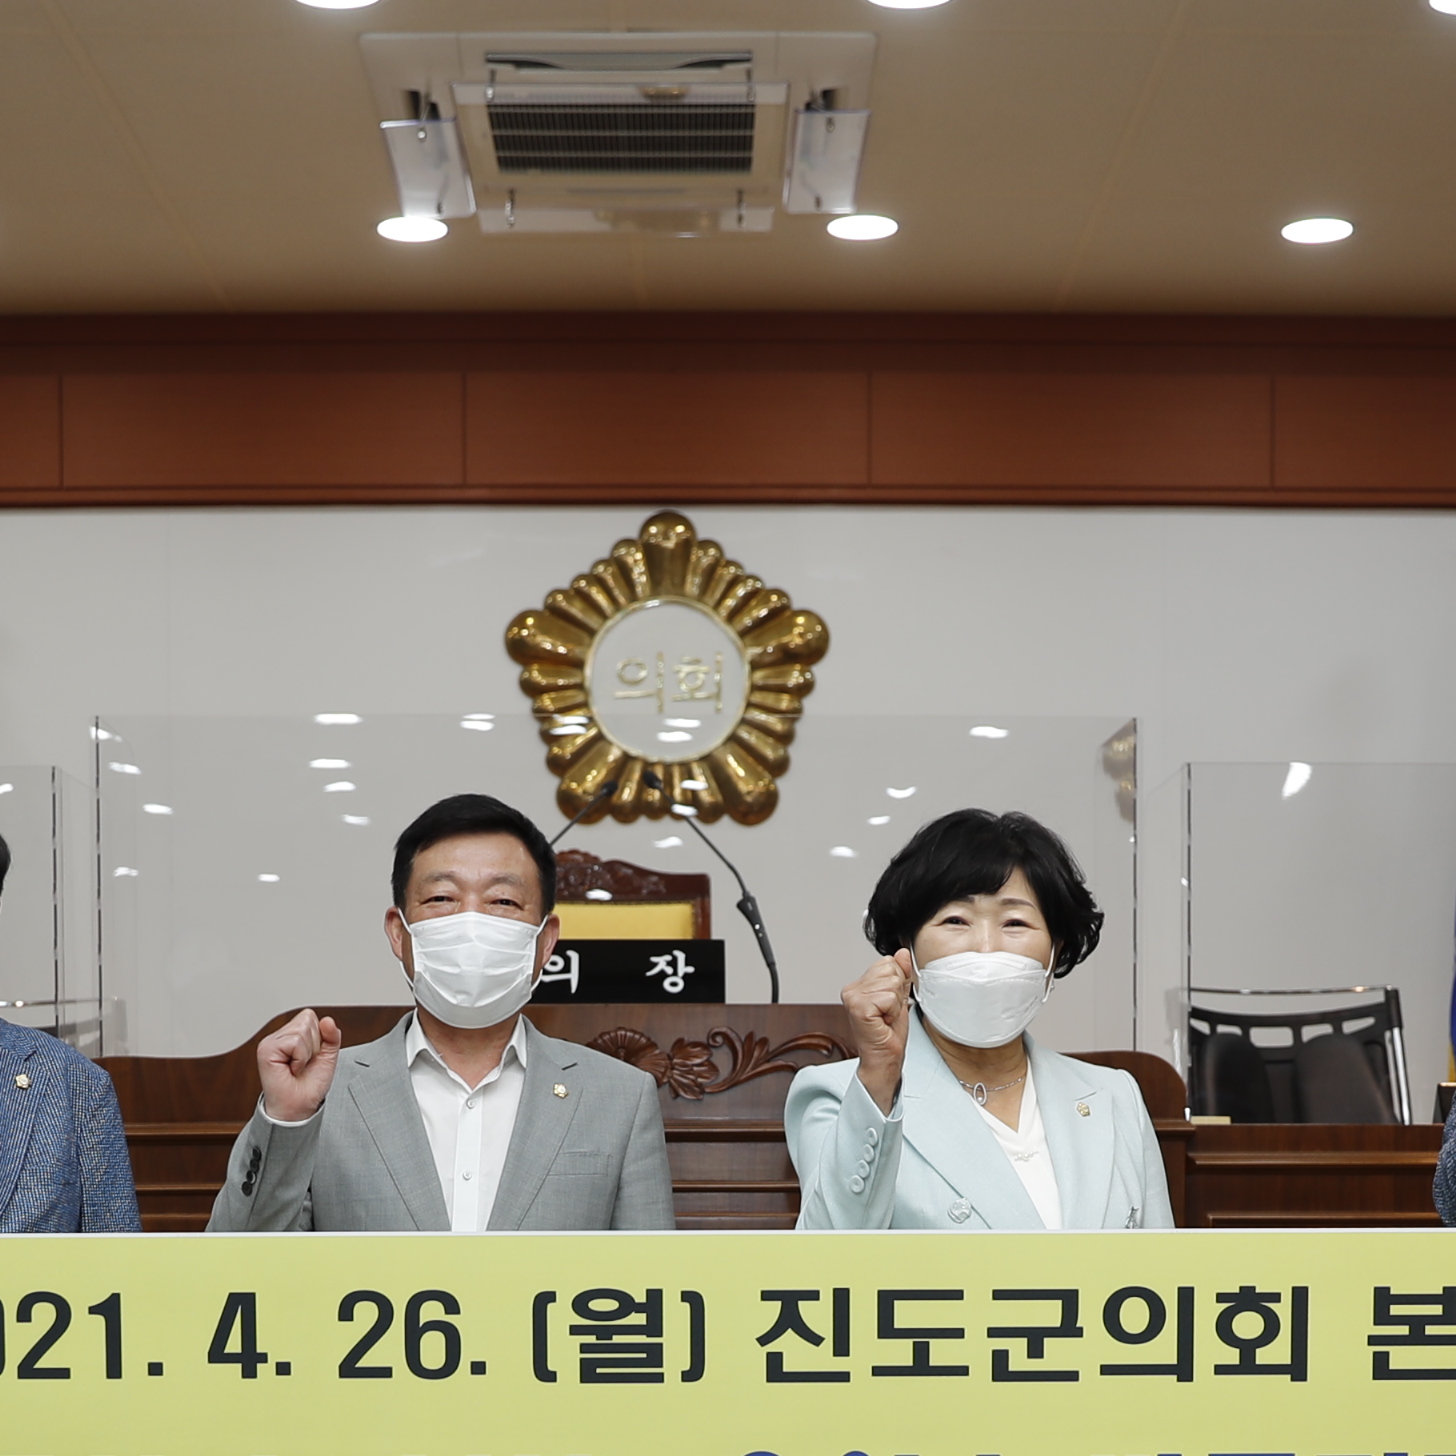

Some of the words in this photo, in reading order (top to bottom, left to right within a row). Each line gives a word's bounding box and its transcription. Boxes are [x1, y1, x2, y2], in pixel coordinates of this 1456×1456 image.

[614, 651, 724, 714] 의회
[208, 1292, 292, 1379] 4.
[339, 1289, 487, 1380] 26.
[756, 1285, 1309, 1383] 진도군의회
